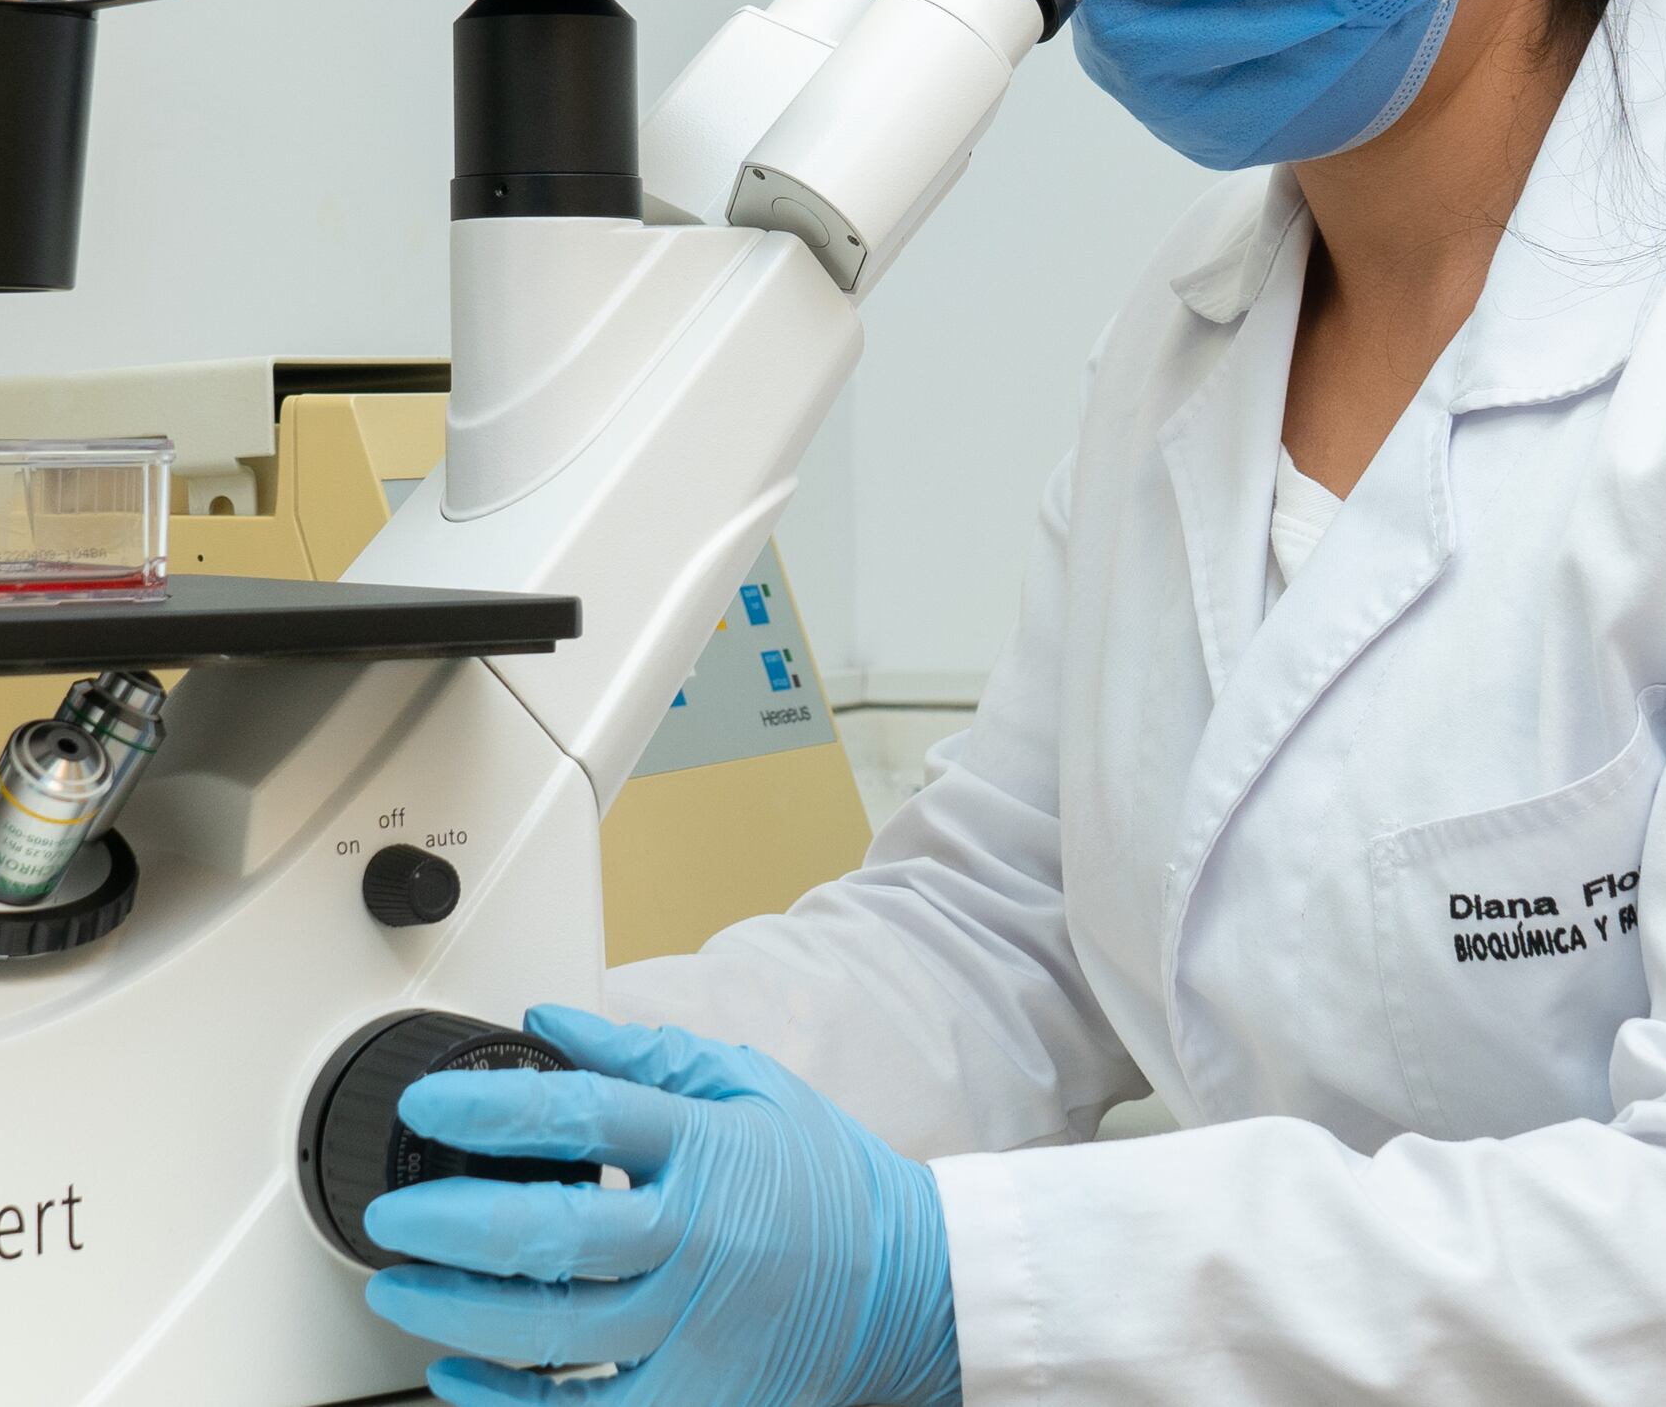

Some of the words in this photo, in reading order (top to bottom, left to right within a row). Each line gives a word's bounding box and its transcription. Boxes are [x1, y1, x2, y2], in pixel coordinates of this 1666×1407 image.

[378, 806, 407, 830] off
[336, 837, 361, 856] on
[424, 828, 468, 849] auto
[1449, 893, 1560, 920] Diana
[1582, 866, 1641, 907] Flo
[1453, 921, 1588, 962] BIOQUÍMICA
[1593, 914, 1608, 941] Y
